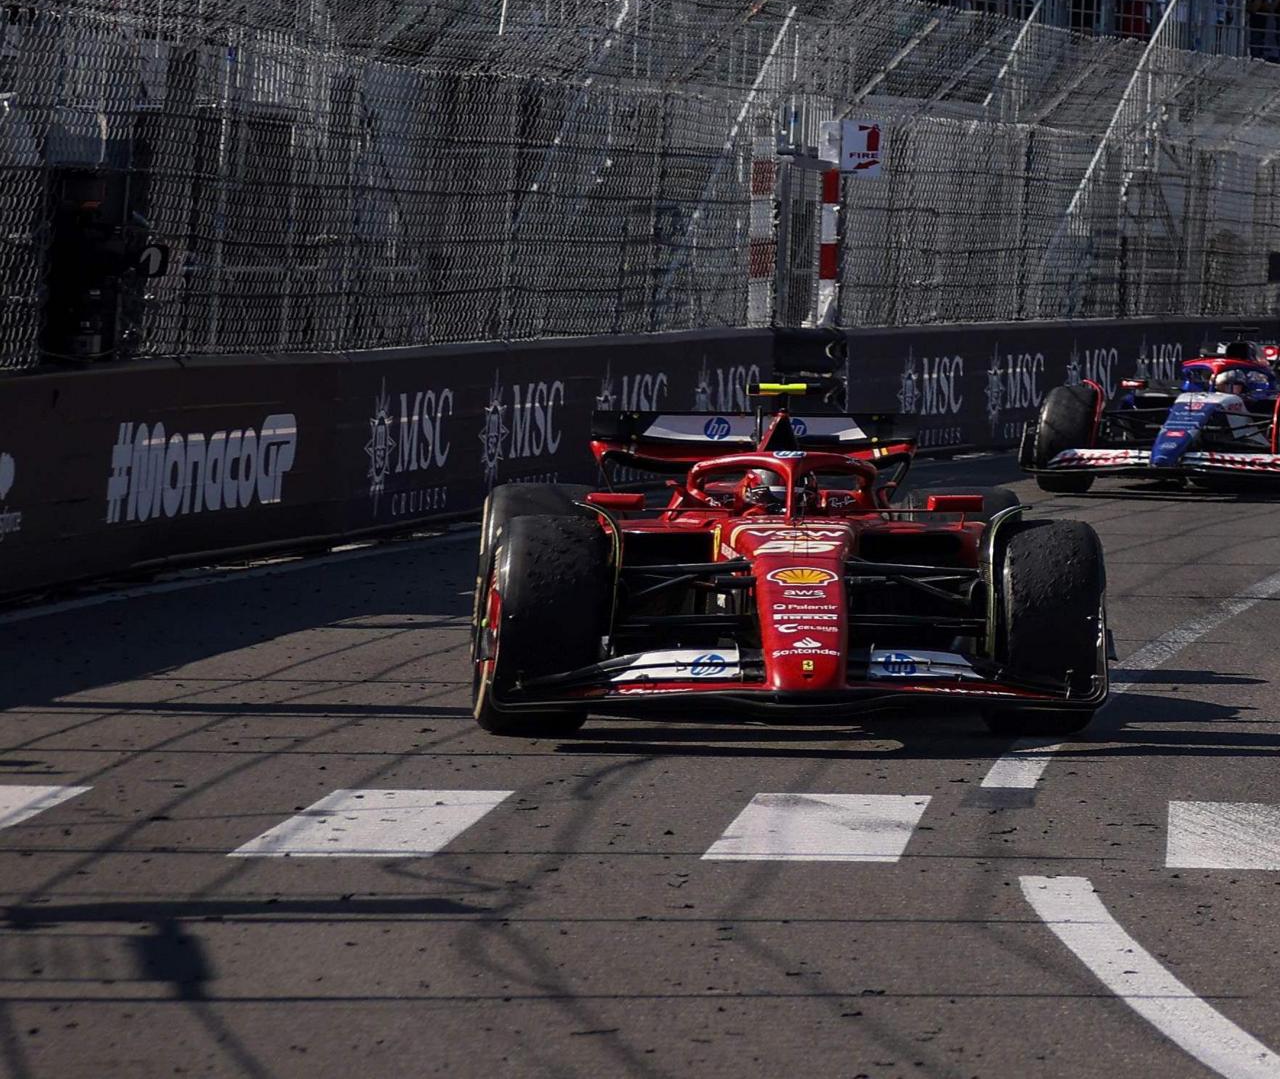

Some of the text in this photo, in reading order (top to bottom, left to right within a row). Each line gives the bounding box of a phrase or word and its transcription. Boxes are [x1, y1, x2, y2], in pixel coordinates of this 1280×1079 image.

[920, 356, 963, 416] MSC
[1006, 352, 1044, 409] MSC
[396, 388, 454, 473] MSC
[509, 381, 564, 458] MSC
[706, 417, 730, 440] hp
[391, 486, 448, 516] CRUISES
[753, 540, 843, 556] 55
[784, 589, 826, 597] aws
